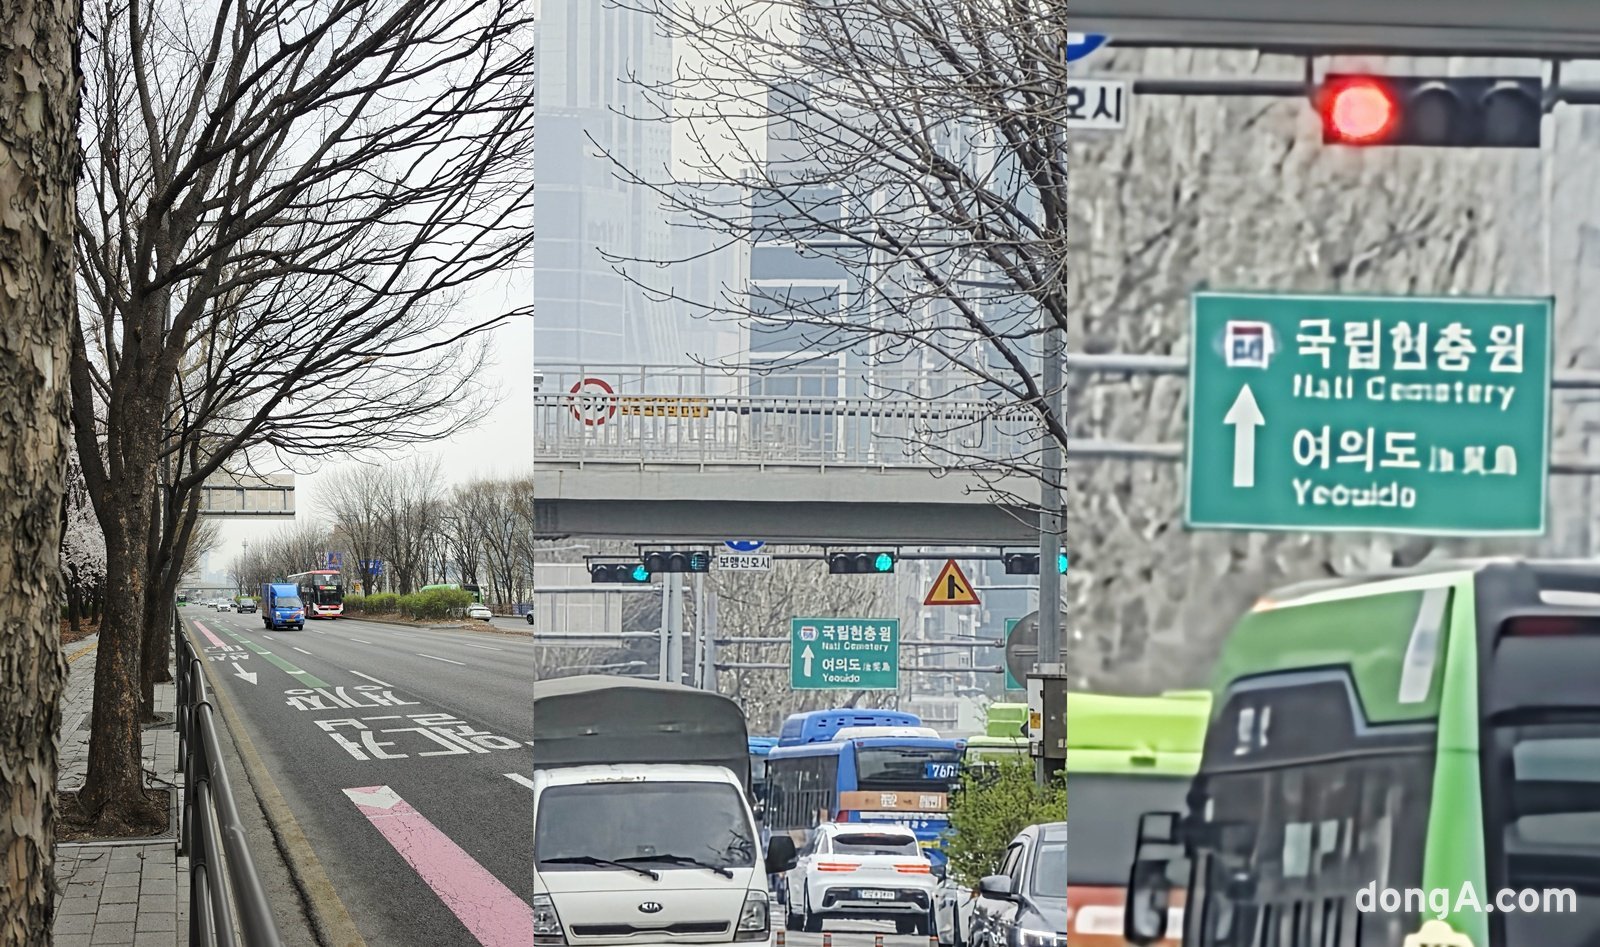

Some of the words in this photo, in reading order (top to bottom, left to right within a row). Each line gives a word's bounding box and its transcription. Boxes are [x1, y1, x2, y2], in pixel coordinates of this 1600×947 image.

[1296, 319, 1524, 373] 국립현충원
[1293, 425, 1421, 473] 여의도
[1293, 478, 1417, 508] Yeouido
[822, 625, 891, 642] 국립현충원
[822, 657, 861, 672] 여의도
[822, 673, 860, 682] Yeouido
[284, 685, 421, 711] 경기장
[313, 712, 523, 761] 월드컵
[641, 902, 660, 910] KIA
